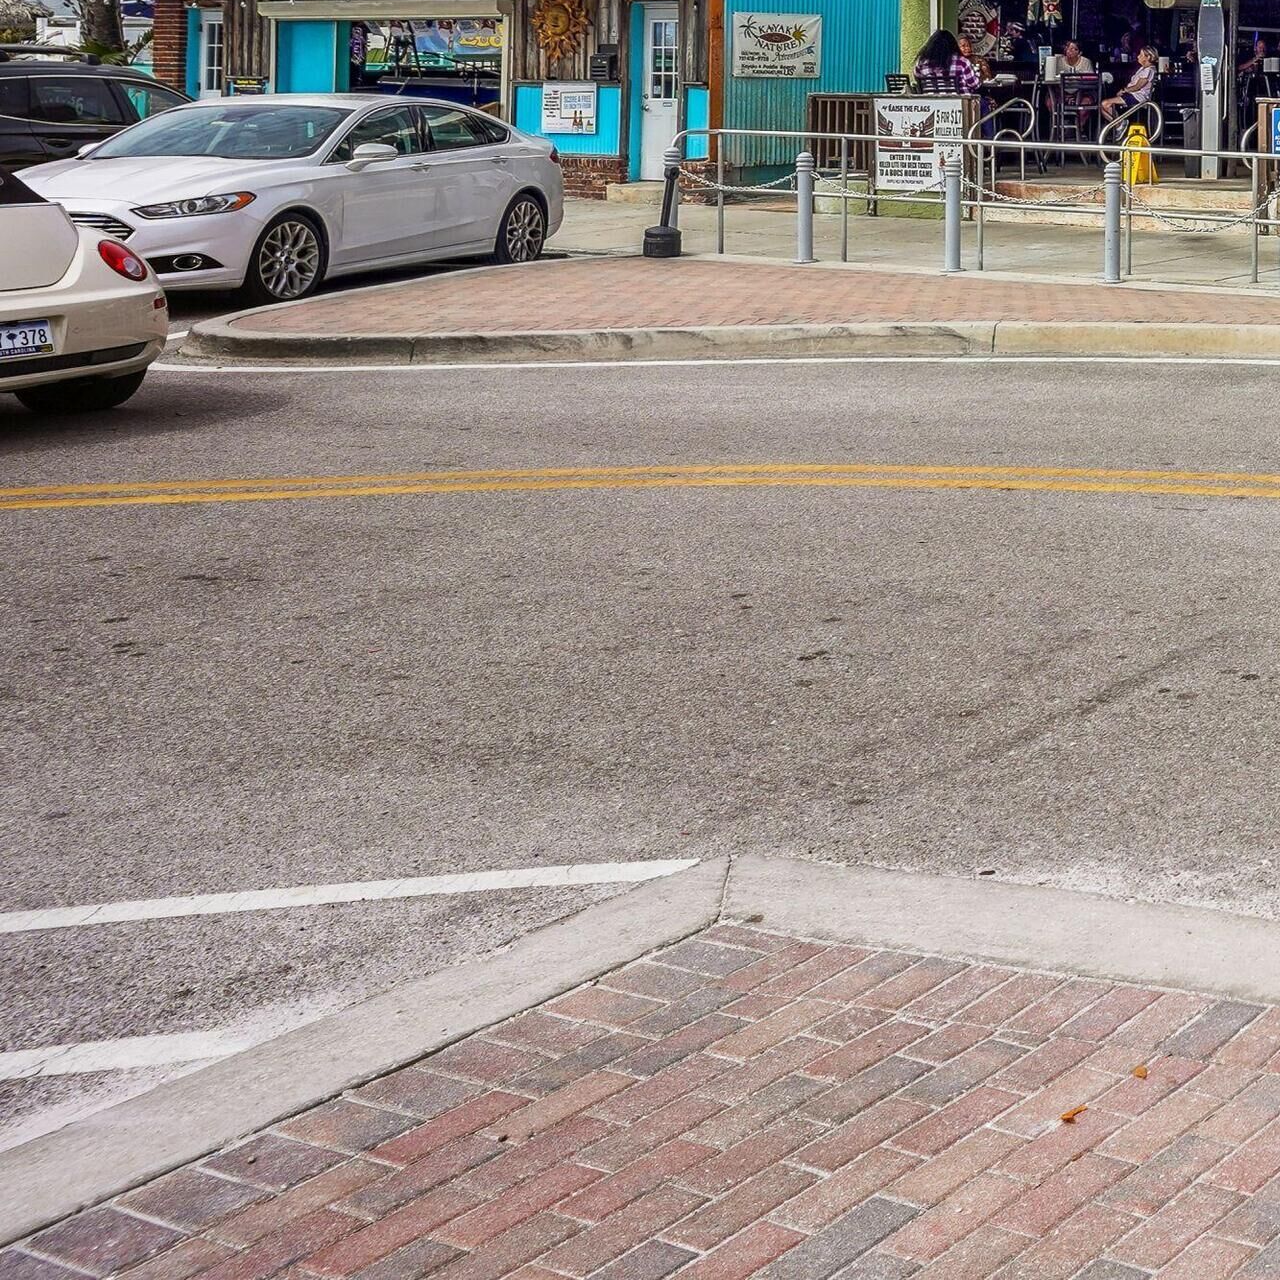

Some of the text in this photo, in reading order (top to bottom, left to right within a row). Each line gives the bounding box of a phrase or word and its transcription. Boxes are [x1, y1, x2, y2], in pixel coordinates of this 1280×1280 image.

[758, 24, 793, 36] KAYAK
[755, 39, 798, 53] NATURE
[904, 105, 913, 113] THE
[914, 105, 931, 113] FLAGS
[941, 111, 950, 123] FOR
[19, 328, 47, 345] 378
